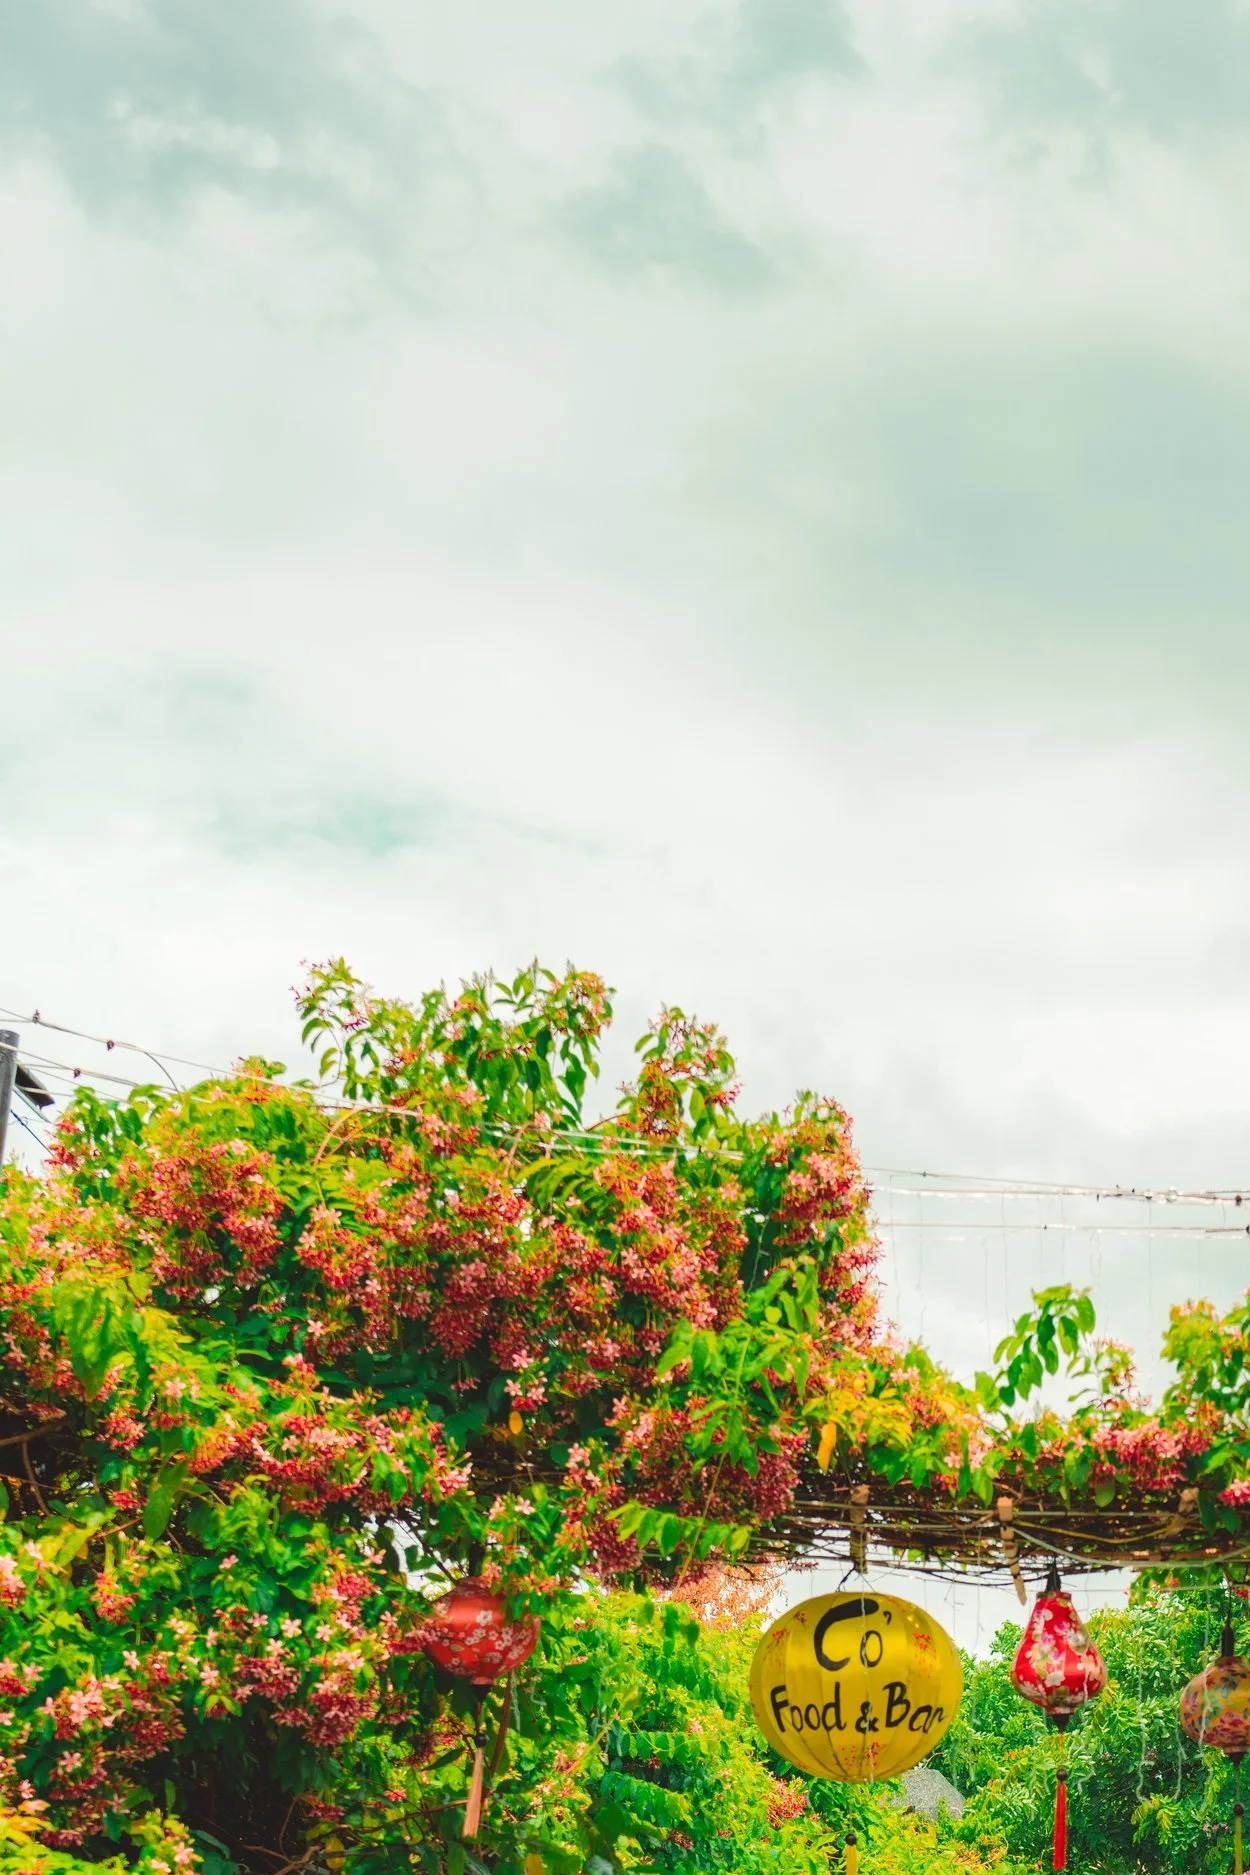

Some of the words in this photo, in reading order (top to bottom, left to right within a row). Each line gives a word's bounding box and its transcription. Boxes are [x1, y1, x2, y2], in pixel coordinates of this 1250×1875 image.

[770, 1681, 847, 1733] Food
[855, 1701, 879, 1734] &
[882, 1681, 946, 1734] Bar
